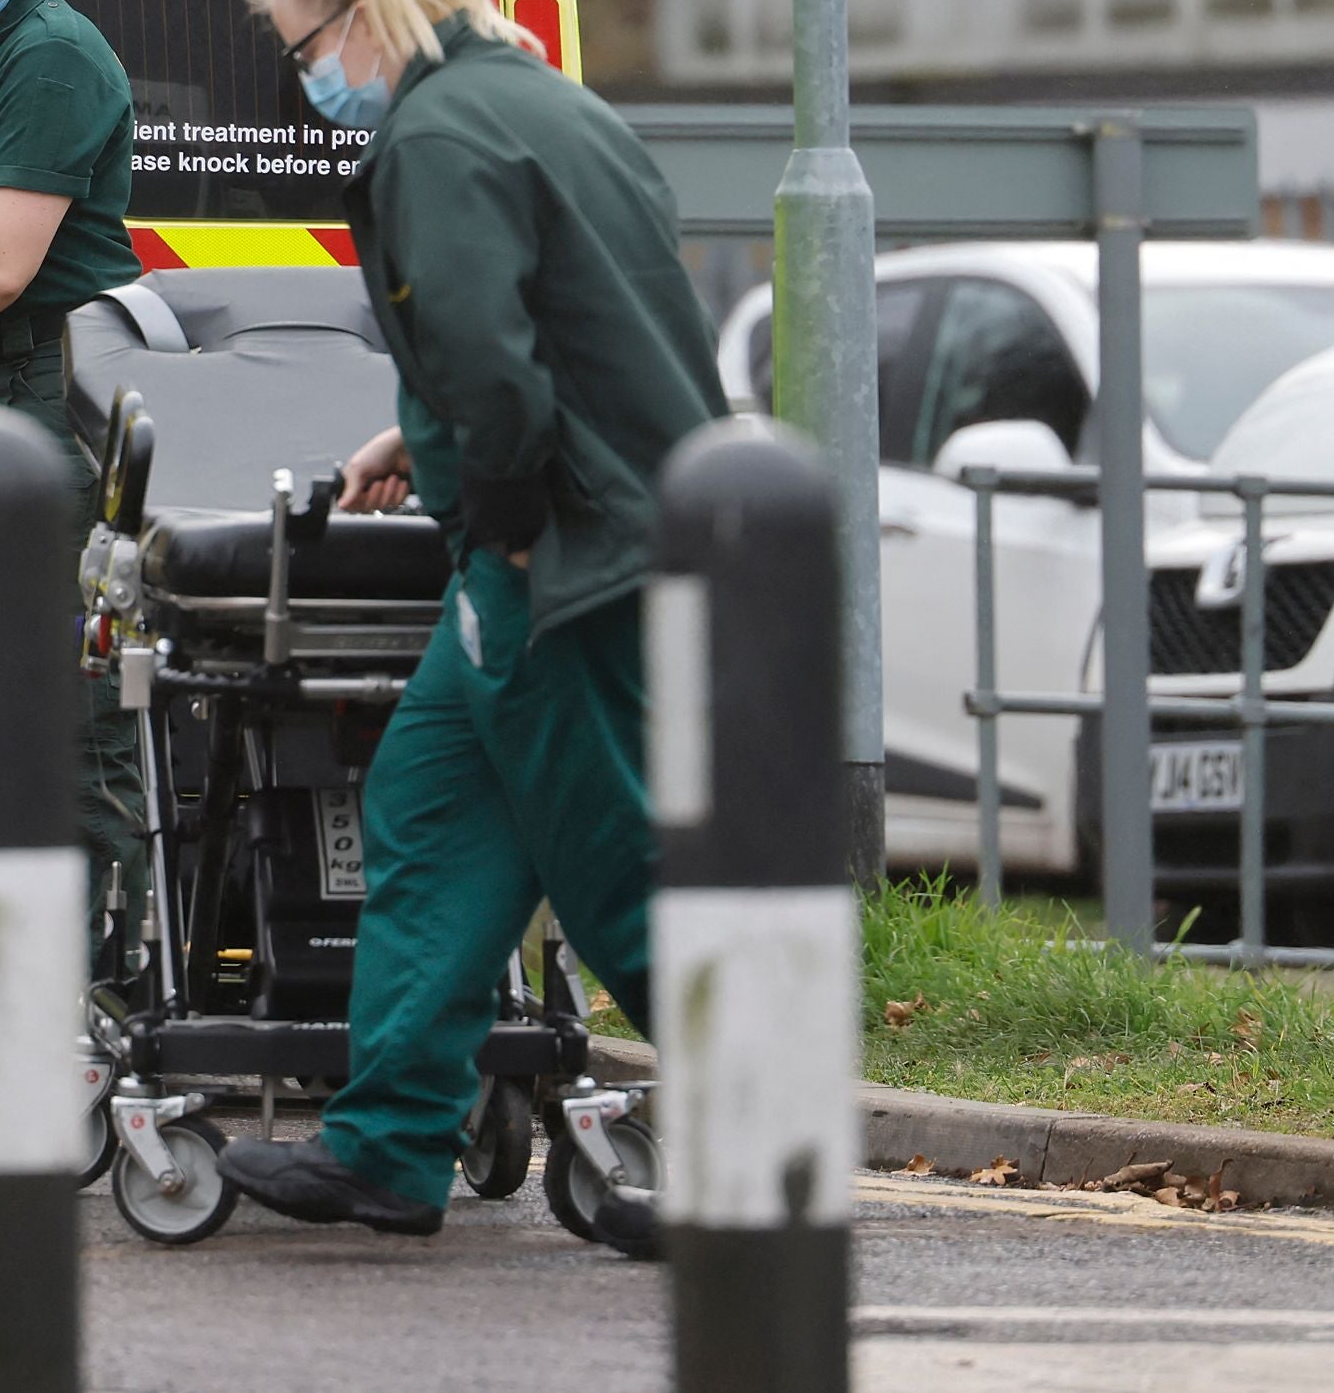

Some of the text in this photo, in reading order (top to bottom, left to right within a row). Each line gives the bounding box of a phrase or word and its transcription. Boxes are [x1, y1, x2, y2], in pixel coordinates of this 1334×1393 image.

[133, 120, 377, 151] ient treatment in pro
[131, 154, 171, 172] ase
[178, 151, 249, 173] knock
[256, 153, 331, 175] before
